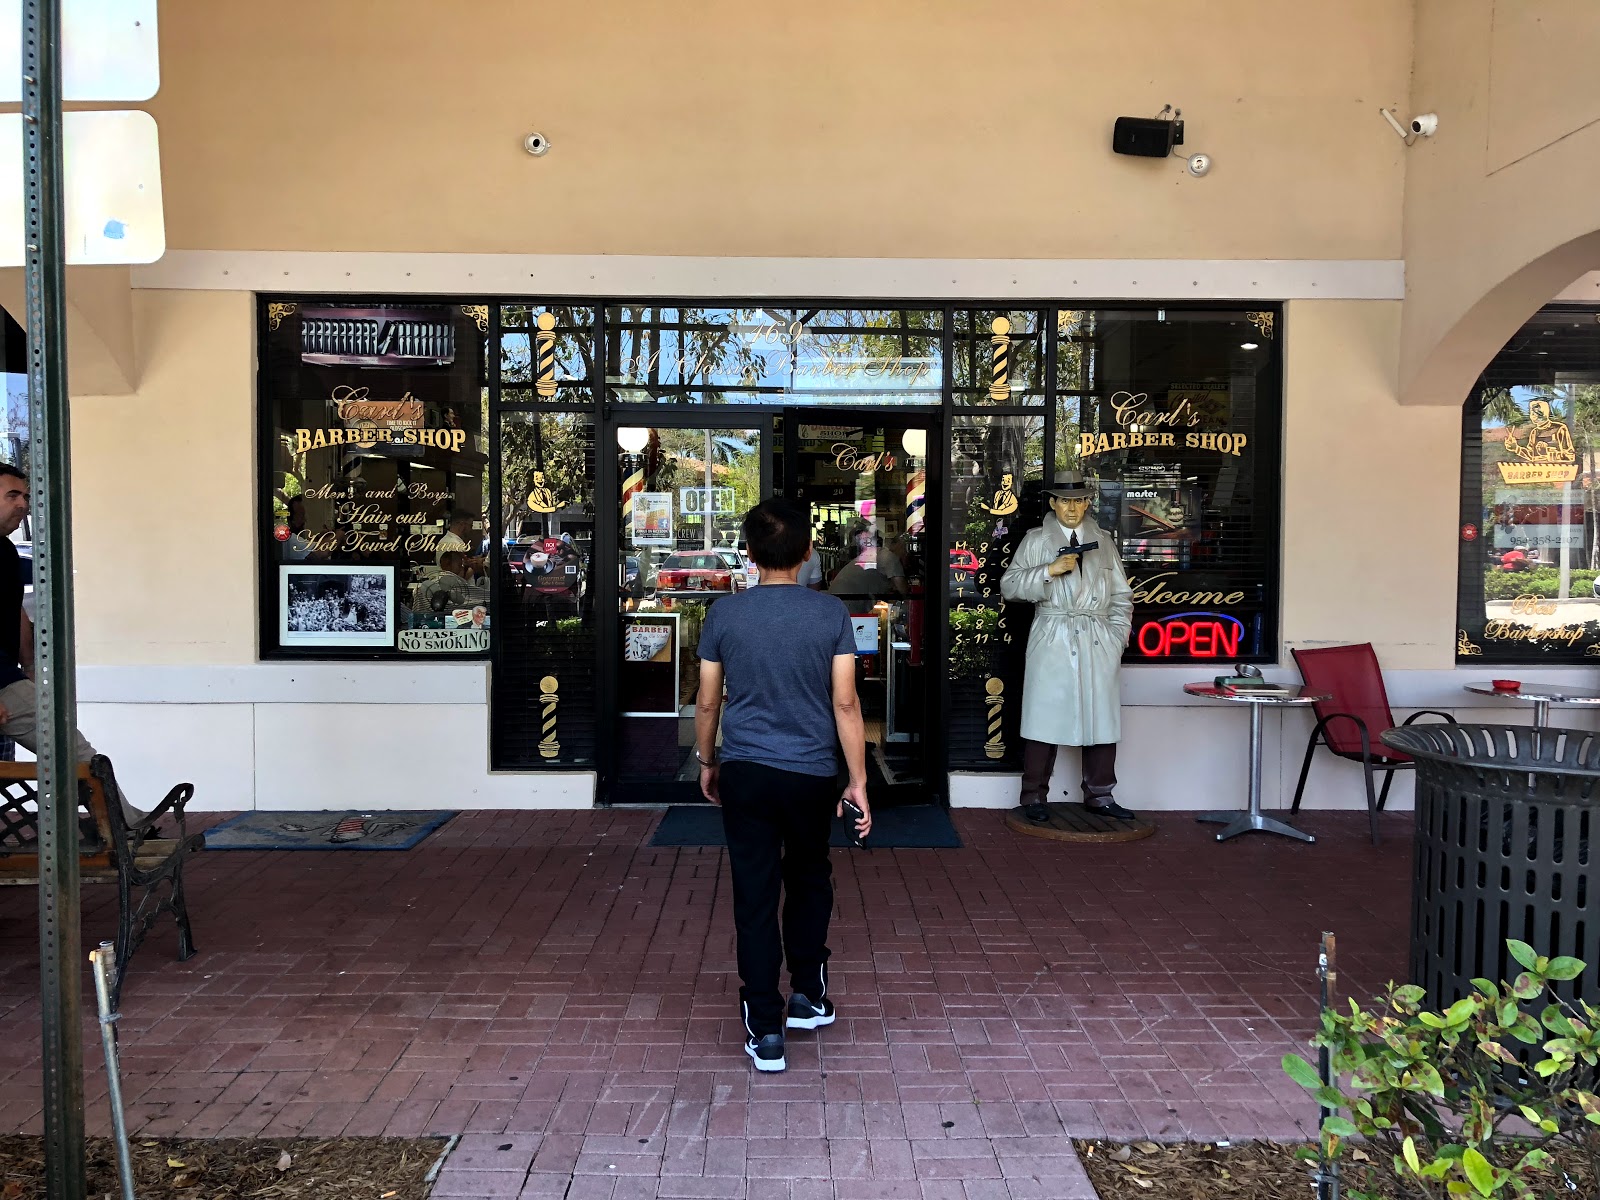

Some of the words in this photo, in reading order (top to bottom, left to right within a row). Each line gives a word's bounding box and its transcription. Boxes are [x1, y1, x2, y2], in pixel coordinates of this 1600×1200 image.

[749, 320, 804, 345] 169
[620, 348, 662, 374] A
[674, 347, 754, 375] Classic
[766, 349, 857, 377] Barber
[864, 345, 931, 385] Shop
[331, 385, 425, 423] Carl's
[1110, 390, 1200, 429] Carl's
[296, 428, 394, 454] BARBER
[405, 428, 466, 453] SHOP
[1079, 432, 1176, 458] BARBER
[1185, 432, 1247, 457] SHOP
[830, 442, 895, 472] Carl's
[1507, 471, 1543, 479] BARBER
[365, 483, 398, 500] and
[685, 489, 733, 512] OPEN
[1127, 490, 1158, 498] master
[337, 501, 393, 525] Hair
[395, 511, 427, 524] cuts
[293, 529, 338, 552] Hot
[341, 529, 403, 552] Towel
[404, 532, 472, 557] Shaves
[677, 528, 696, 538] CREW
[1510, 593, 1557, 616] Best
[401, 638, 421, 650] NO
[424, 630, 488, 650] SMOKING
[404, 631, 458, 639] PLEASE
[632, 626, 668, 634] BARBER
[1138, 621, 1239, 657] OPEN
[1484, 617, 1584, 647] Barbershop
